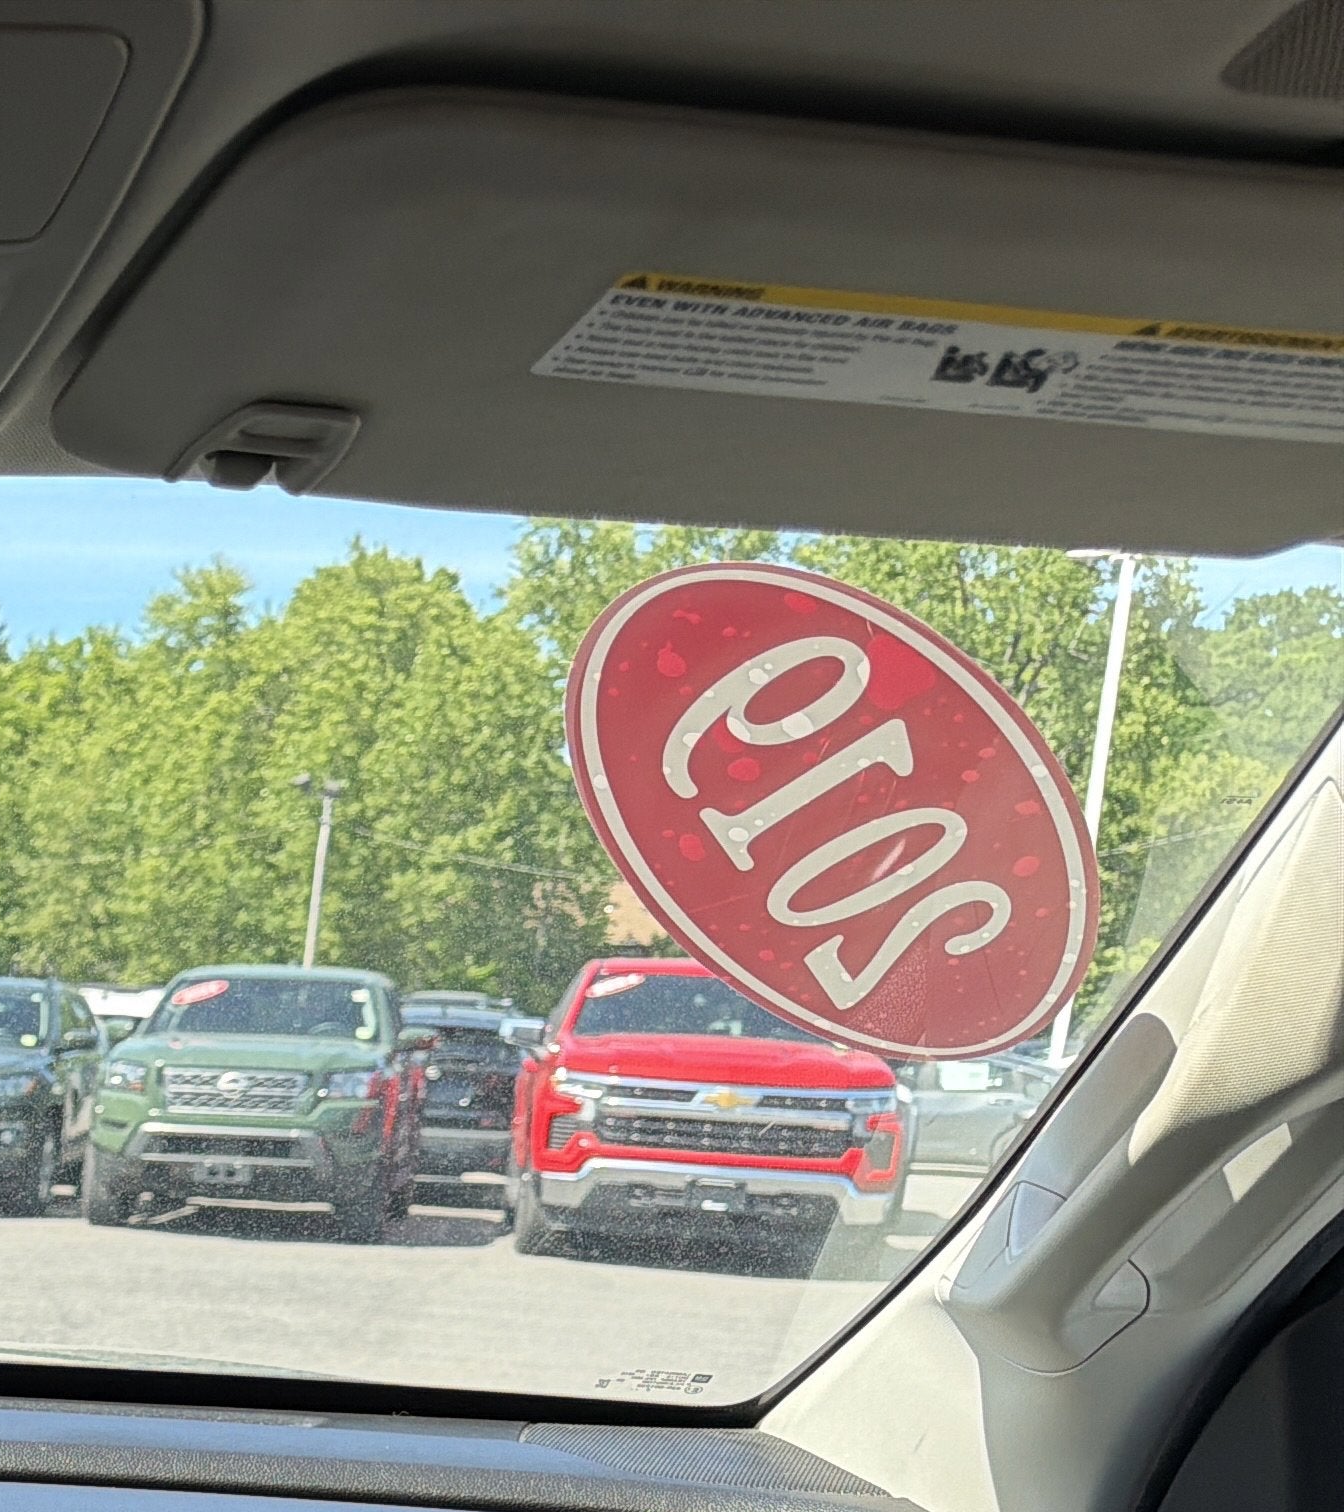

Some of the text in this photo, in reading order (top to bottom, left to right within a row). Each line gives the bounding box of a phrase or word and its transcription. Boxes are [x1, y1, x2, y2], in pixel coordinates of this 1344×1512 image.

[610, 293, 667, 309] EVEN
[671, 298, 726, 316] WITH
[736, 306, 849, 328] ADVANCED
[857, 317, 898, 331] AIR
